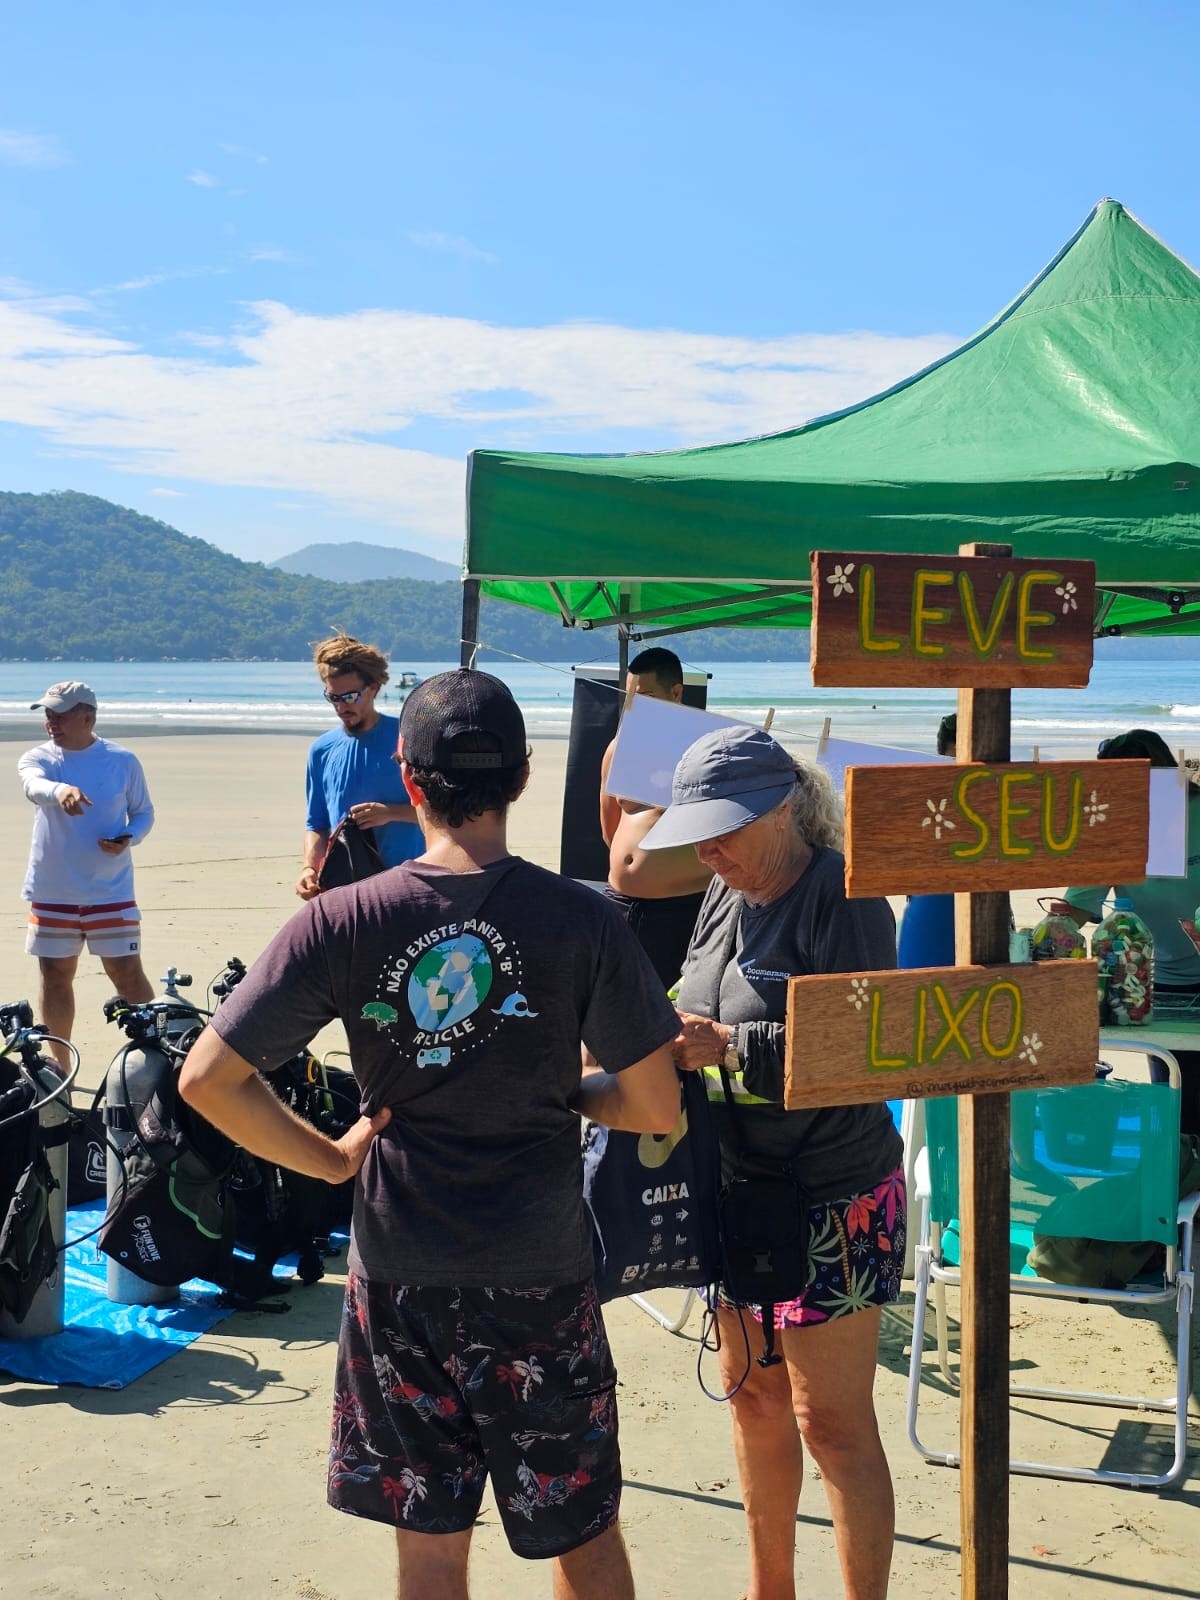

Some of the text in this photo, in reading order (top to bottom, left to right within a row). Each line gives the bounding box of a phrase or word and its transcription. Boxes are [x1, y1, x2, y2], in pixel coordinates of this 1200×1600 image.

[858, 564, 1063, 661] LEVE
[952, 769, 1082, 862] SEU
[386, 958, 409, 993] NÃO
[406, 923, 458, 958] EXISTE
[867, 979, 1023, 1072] LIXO
[641, 1182, 690, 1206] CAIXA
